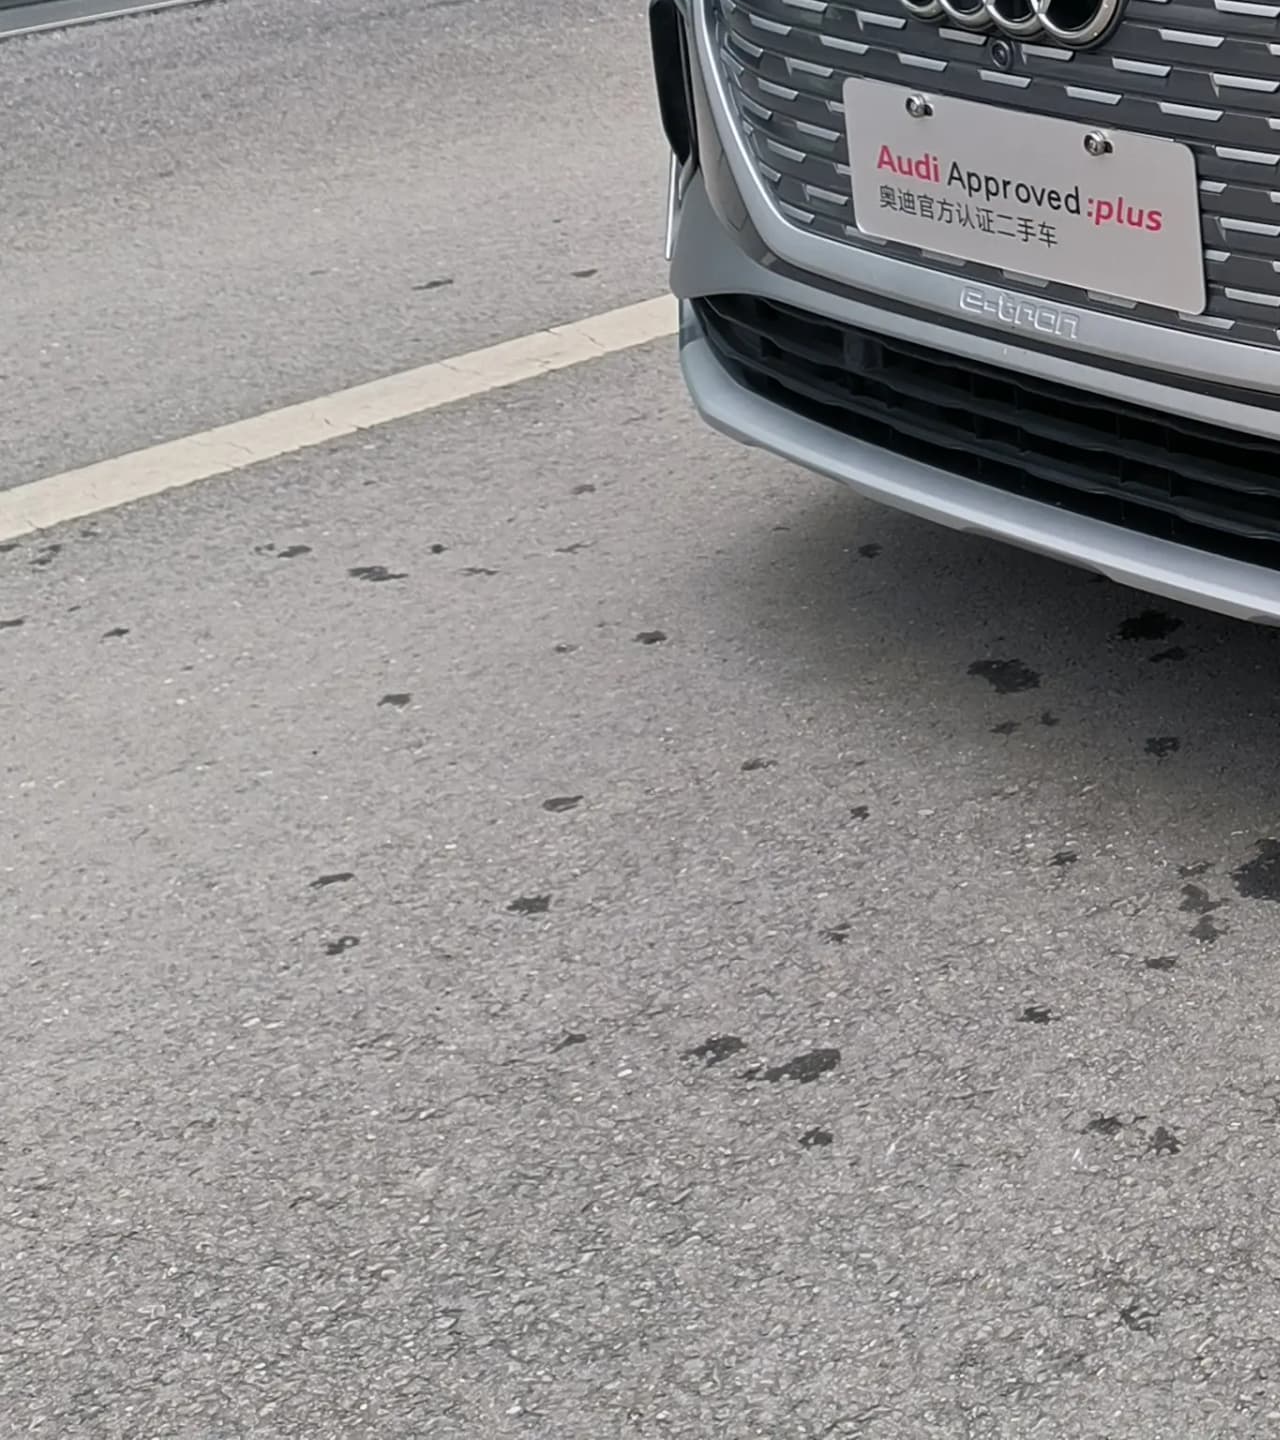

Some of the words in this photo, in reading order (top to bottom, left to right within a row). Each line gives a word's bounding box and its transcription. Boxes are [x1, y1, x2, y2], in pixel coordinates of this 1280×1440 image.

[877, 144, 940, 183] Audi
[947, 161, 1081, 215] Approved
[879, 183, 1059, 249] 奥迪官方认证二手车
[959, 286, 1080, 340] e-tron
